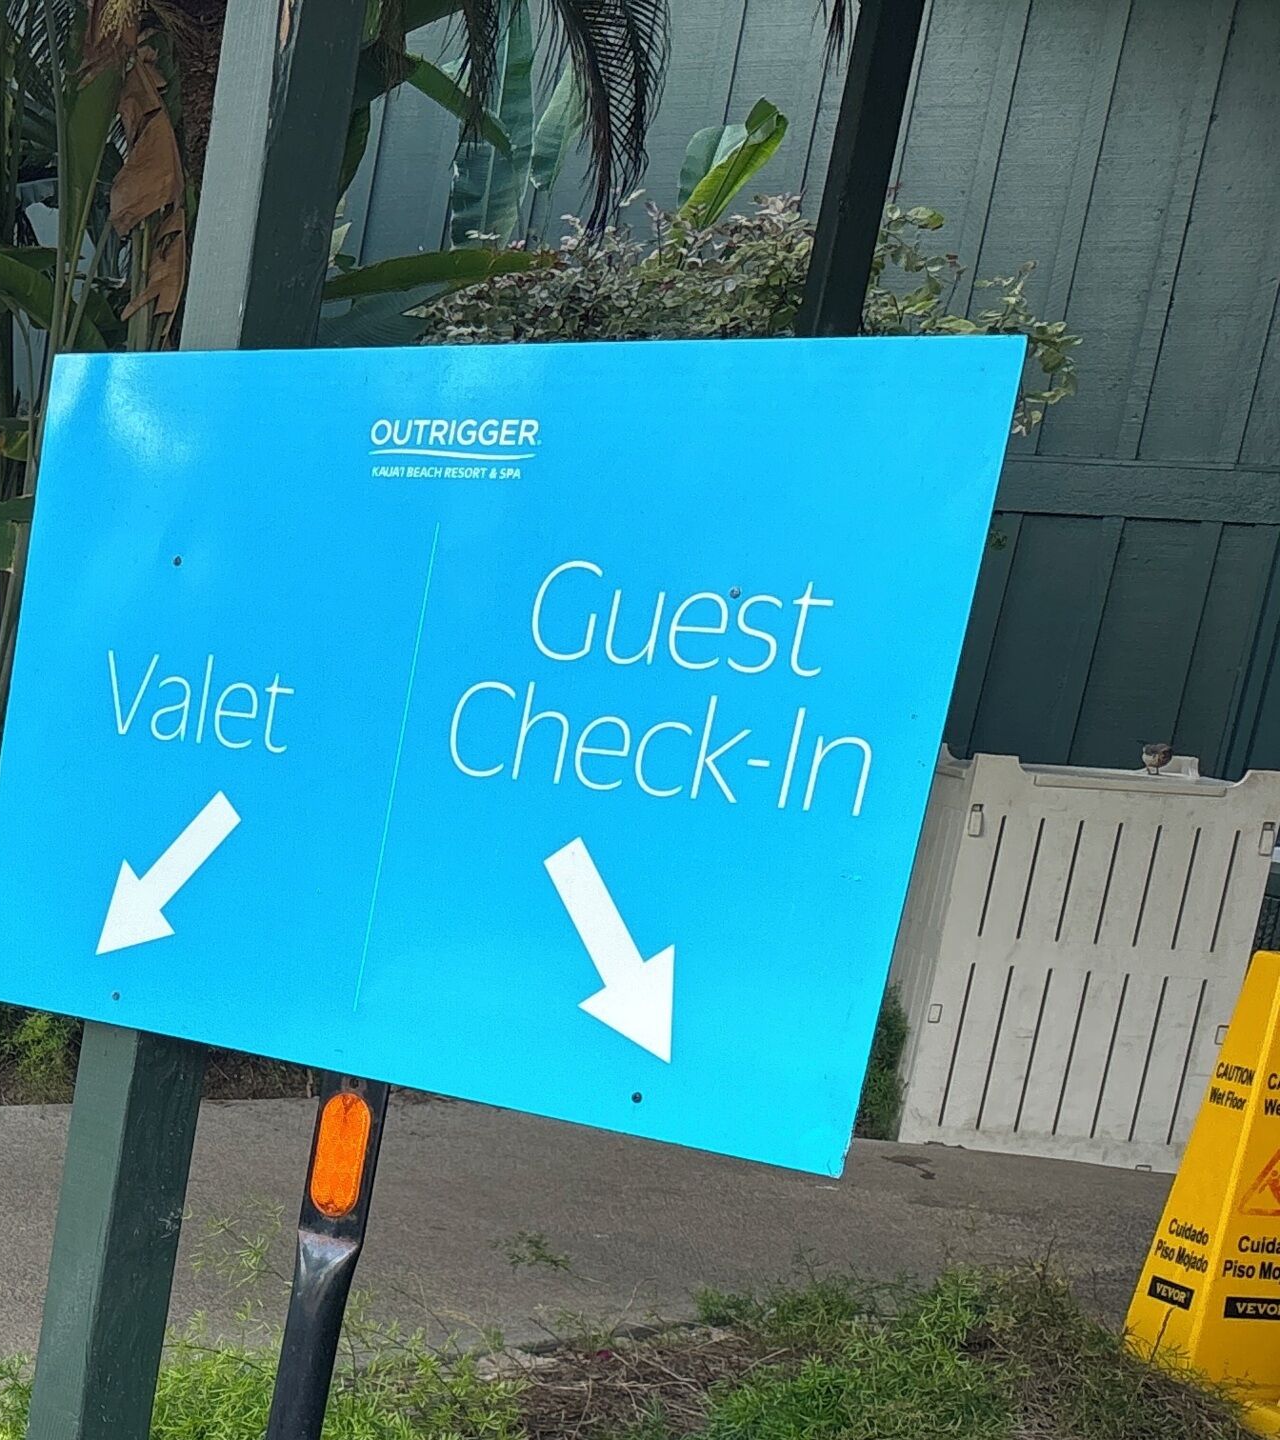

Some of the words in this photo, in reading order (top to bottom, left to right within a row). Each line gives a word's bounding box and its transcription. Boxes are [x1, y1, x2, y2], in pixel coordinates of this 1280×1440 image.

[370, 418, 539, 446] OUTRIGGER
[406, 466, 443, 479] BEACH
[443, 467, 487, 479] RESORT
[489, 467, 497, 480] &
[499, 467, 522, 480] SPA
[531, 560, 835, 677] Guest
[108, 651, 295, 753] Valet
[450, 681, 873, 817] Check-In
[1216, 1061, 1256, 1086] CAUTION
[1209, 1086, 1226, 1106] Wet
[1224, 1090, 1247, 1111] Floor
[1168, 1218, 1209, 1246] Cuidado
[1154, 1238, 1176, 1262] Piso
[1175, 1246, 1209, 1273] Mojado
[1222, 1259, 1256, 1279] Piso
[1155, 1282, 1187, 1304] VEVOR
[1236, 1302, 1280, 1316] VEVO
